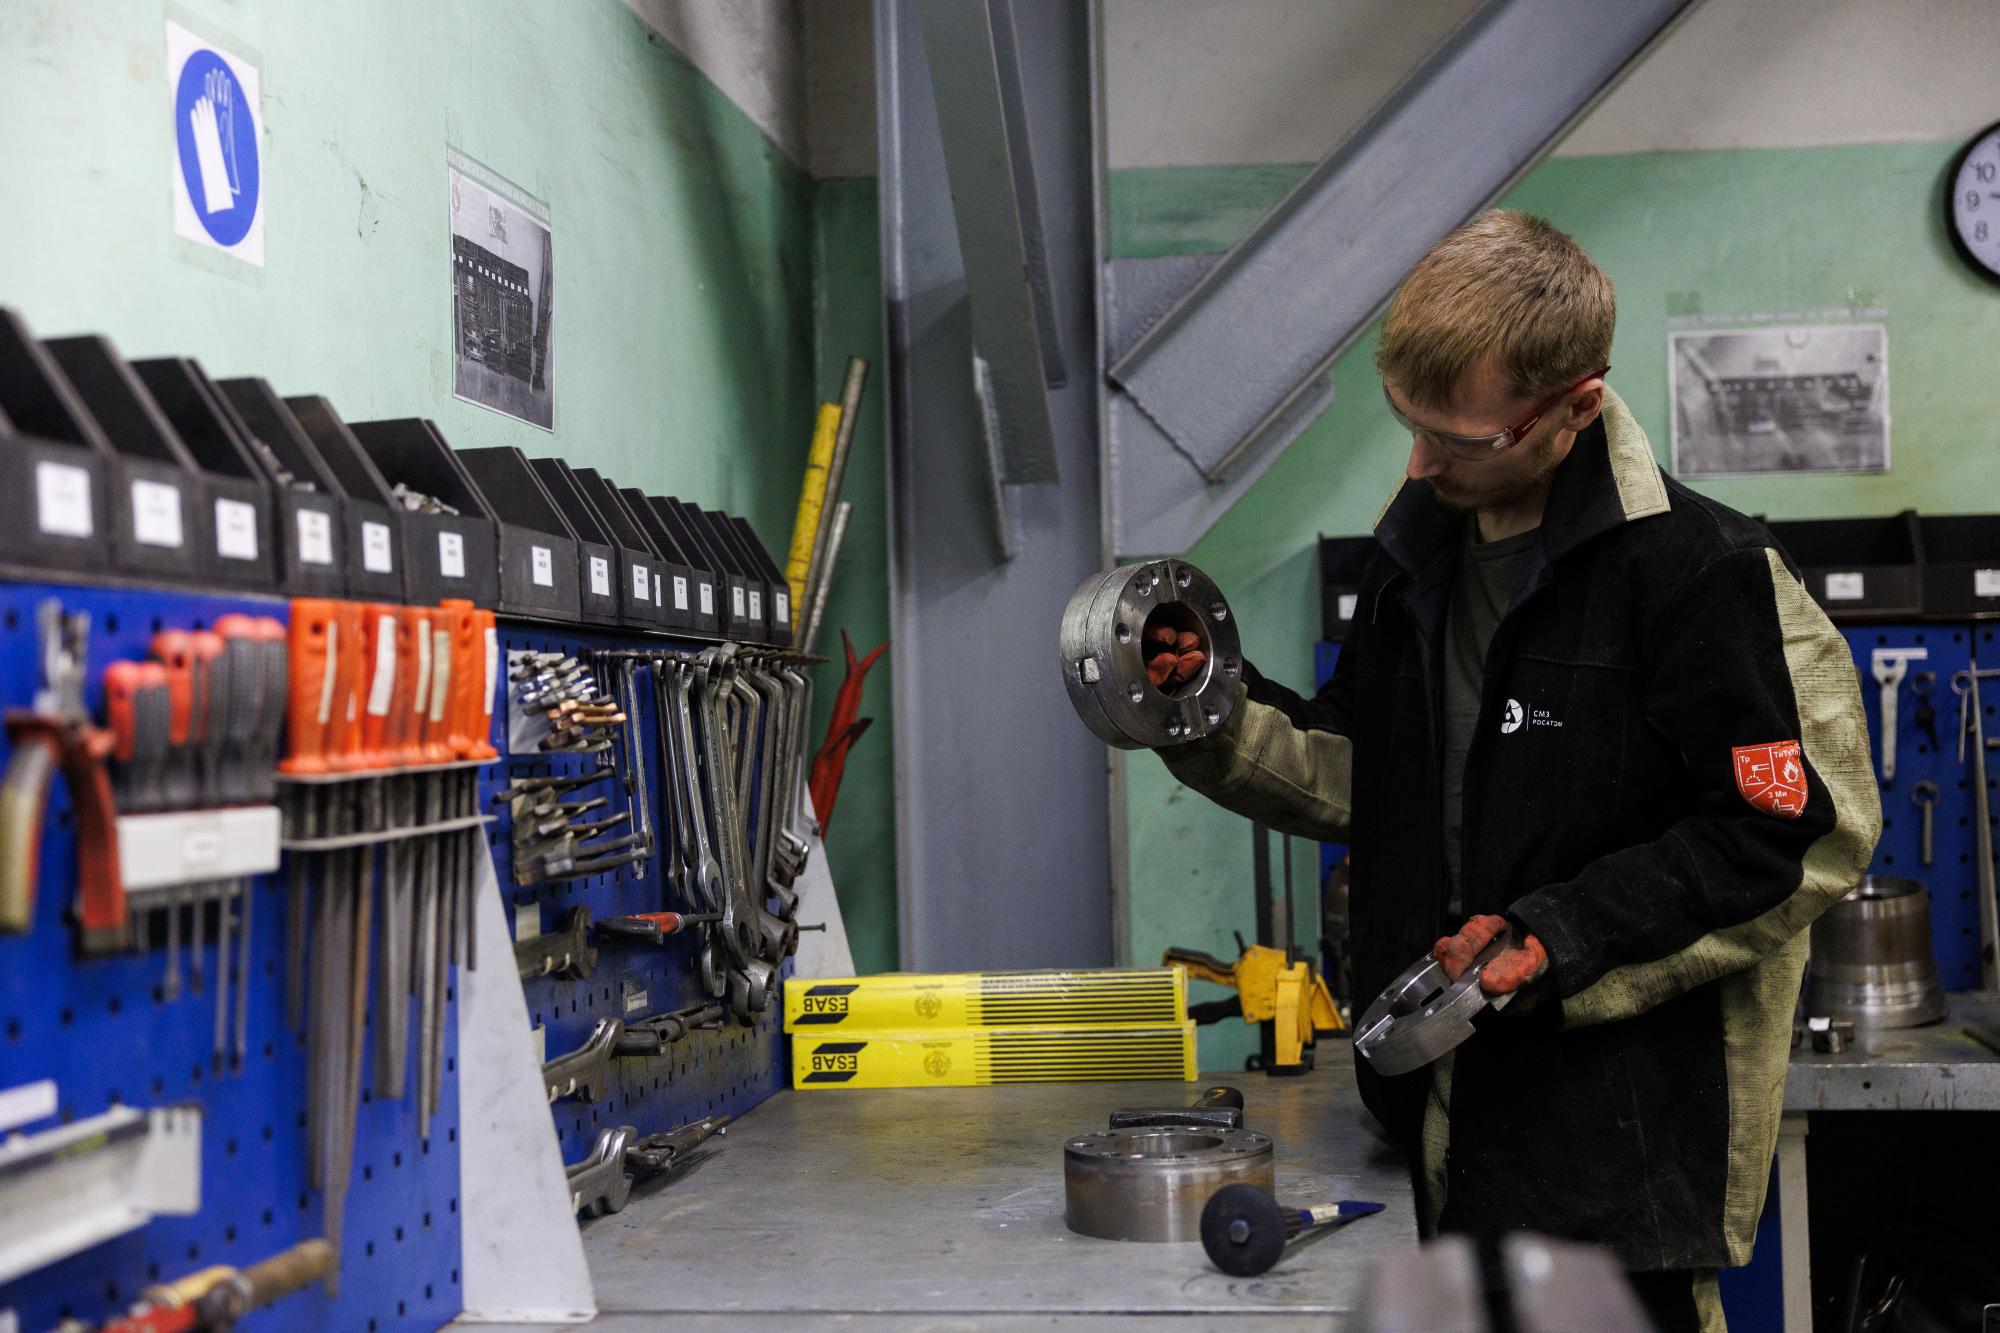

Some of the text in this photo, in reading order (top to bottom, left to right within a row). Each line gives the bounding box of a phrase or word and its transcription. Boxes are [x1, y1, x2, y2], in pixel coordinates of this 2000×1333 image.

[1975, 161, 1996, 183] 10
[1966, 190, 1980, 212] 9
[1974, 219, 1989, 242] 8
[803, 997, 849, 1012] ESAB
[812, 1055, 858, 1070] ESAB
